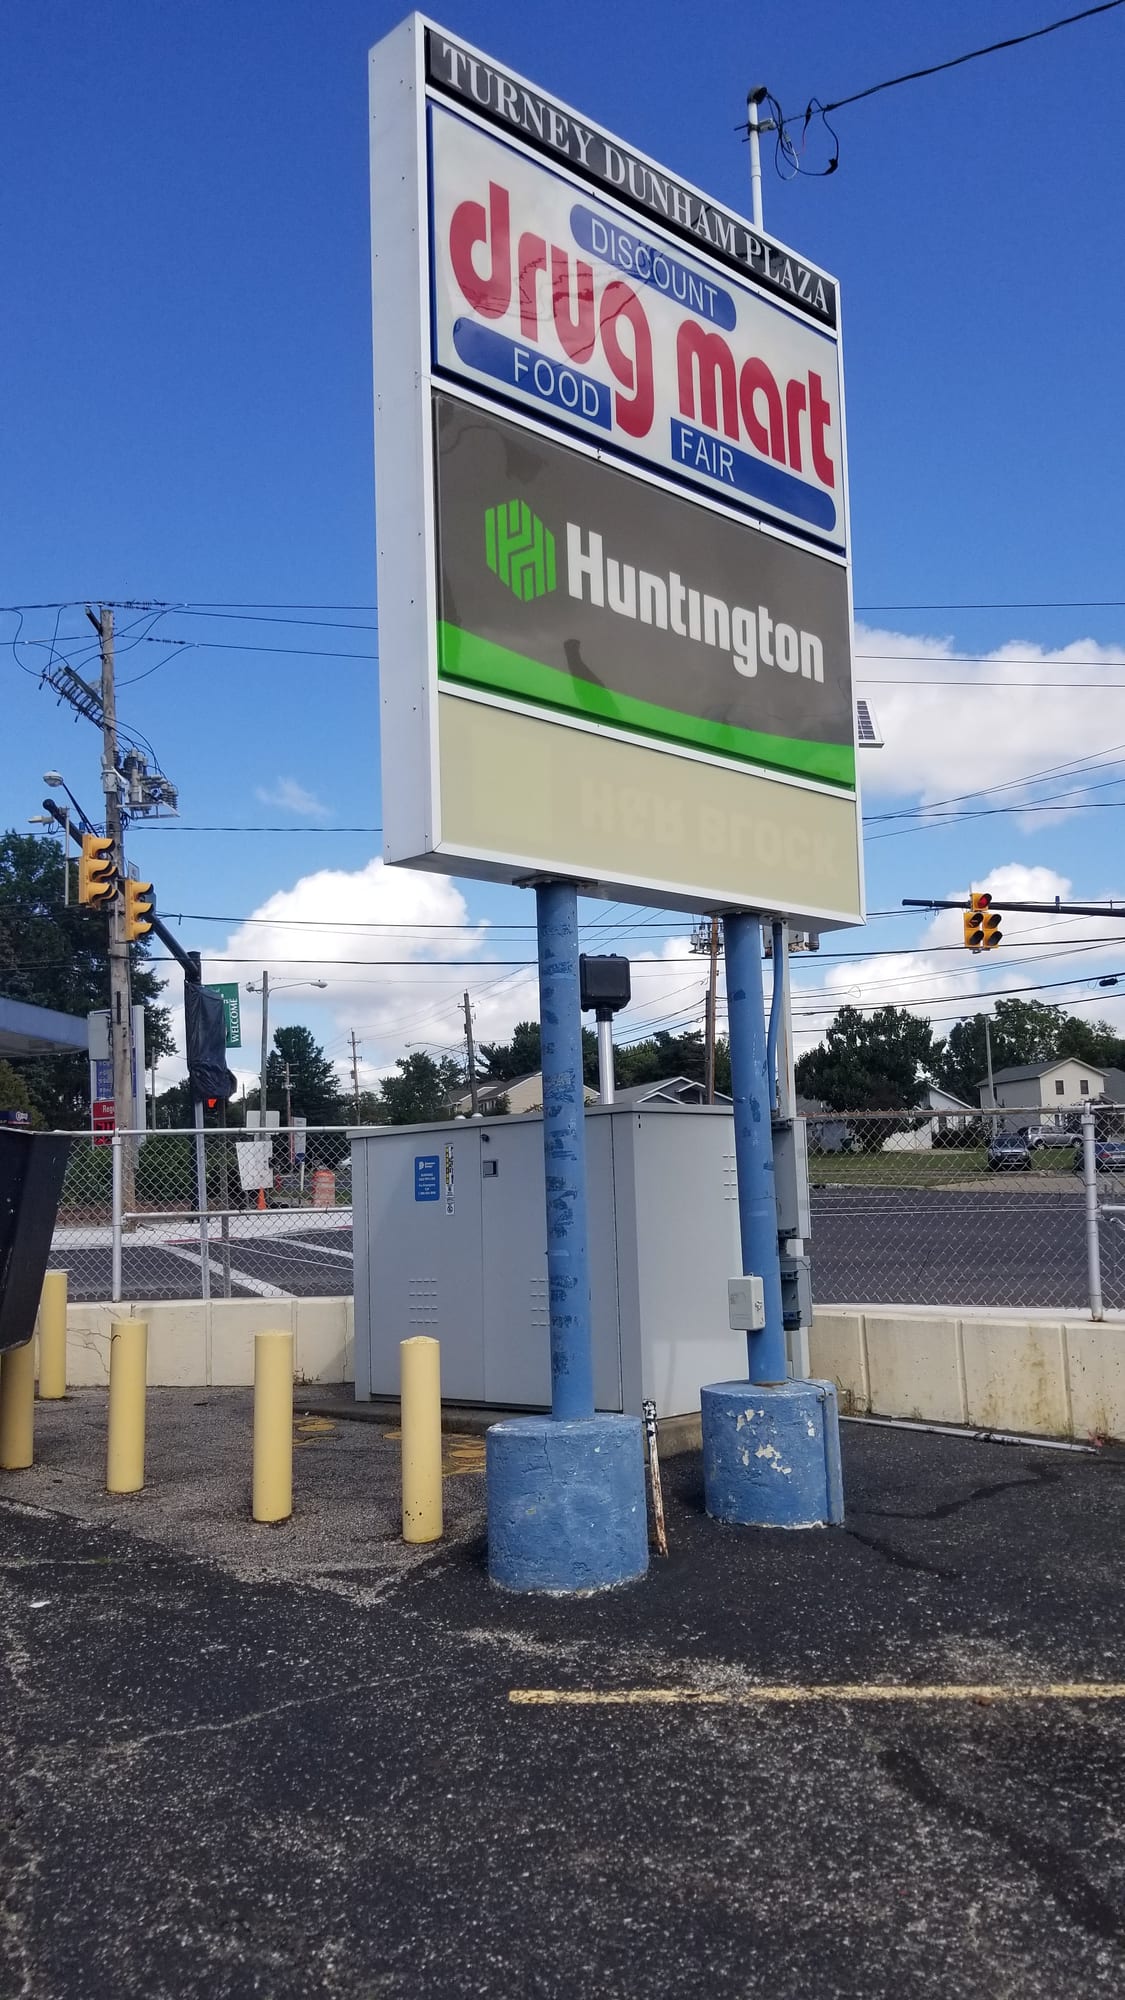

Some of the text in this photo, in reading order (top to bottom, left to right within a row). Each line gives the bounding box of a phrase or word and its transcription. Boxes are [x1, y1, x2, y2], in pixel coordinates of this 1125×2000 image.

[442, 42, 831, 315] TURNEY DUNHAM PLAZA
[449, 181, 835, 489] drug mart
[592, 218, 718, 319] DISCOUNT
[514, 348, 735, 483] FOOD FAIR
[566, 522, 825, 684] Huntington
[231, 997, 240, 1043] WELCOME
